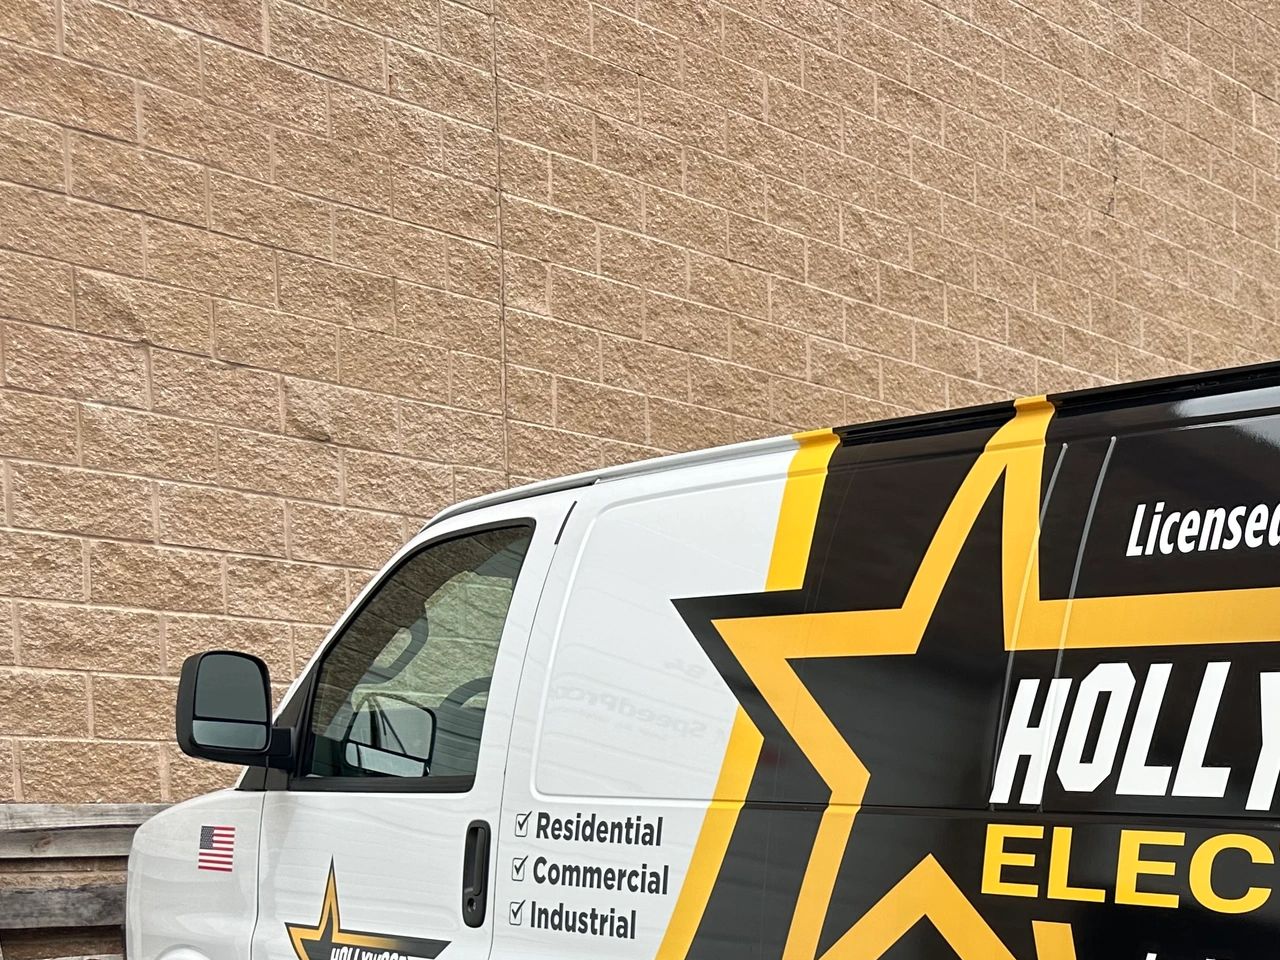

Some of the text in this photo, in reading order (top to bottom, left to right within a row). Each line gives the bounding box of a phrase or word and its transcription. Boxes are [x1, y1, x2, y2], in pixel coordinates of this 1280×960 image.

[535, 811, 663, 847] Residential
[532, 855, 669, 896] Commercial
[529, 900, 636, 940] Industrial
